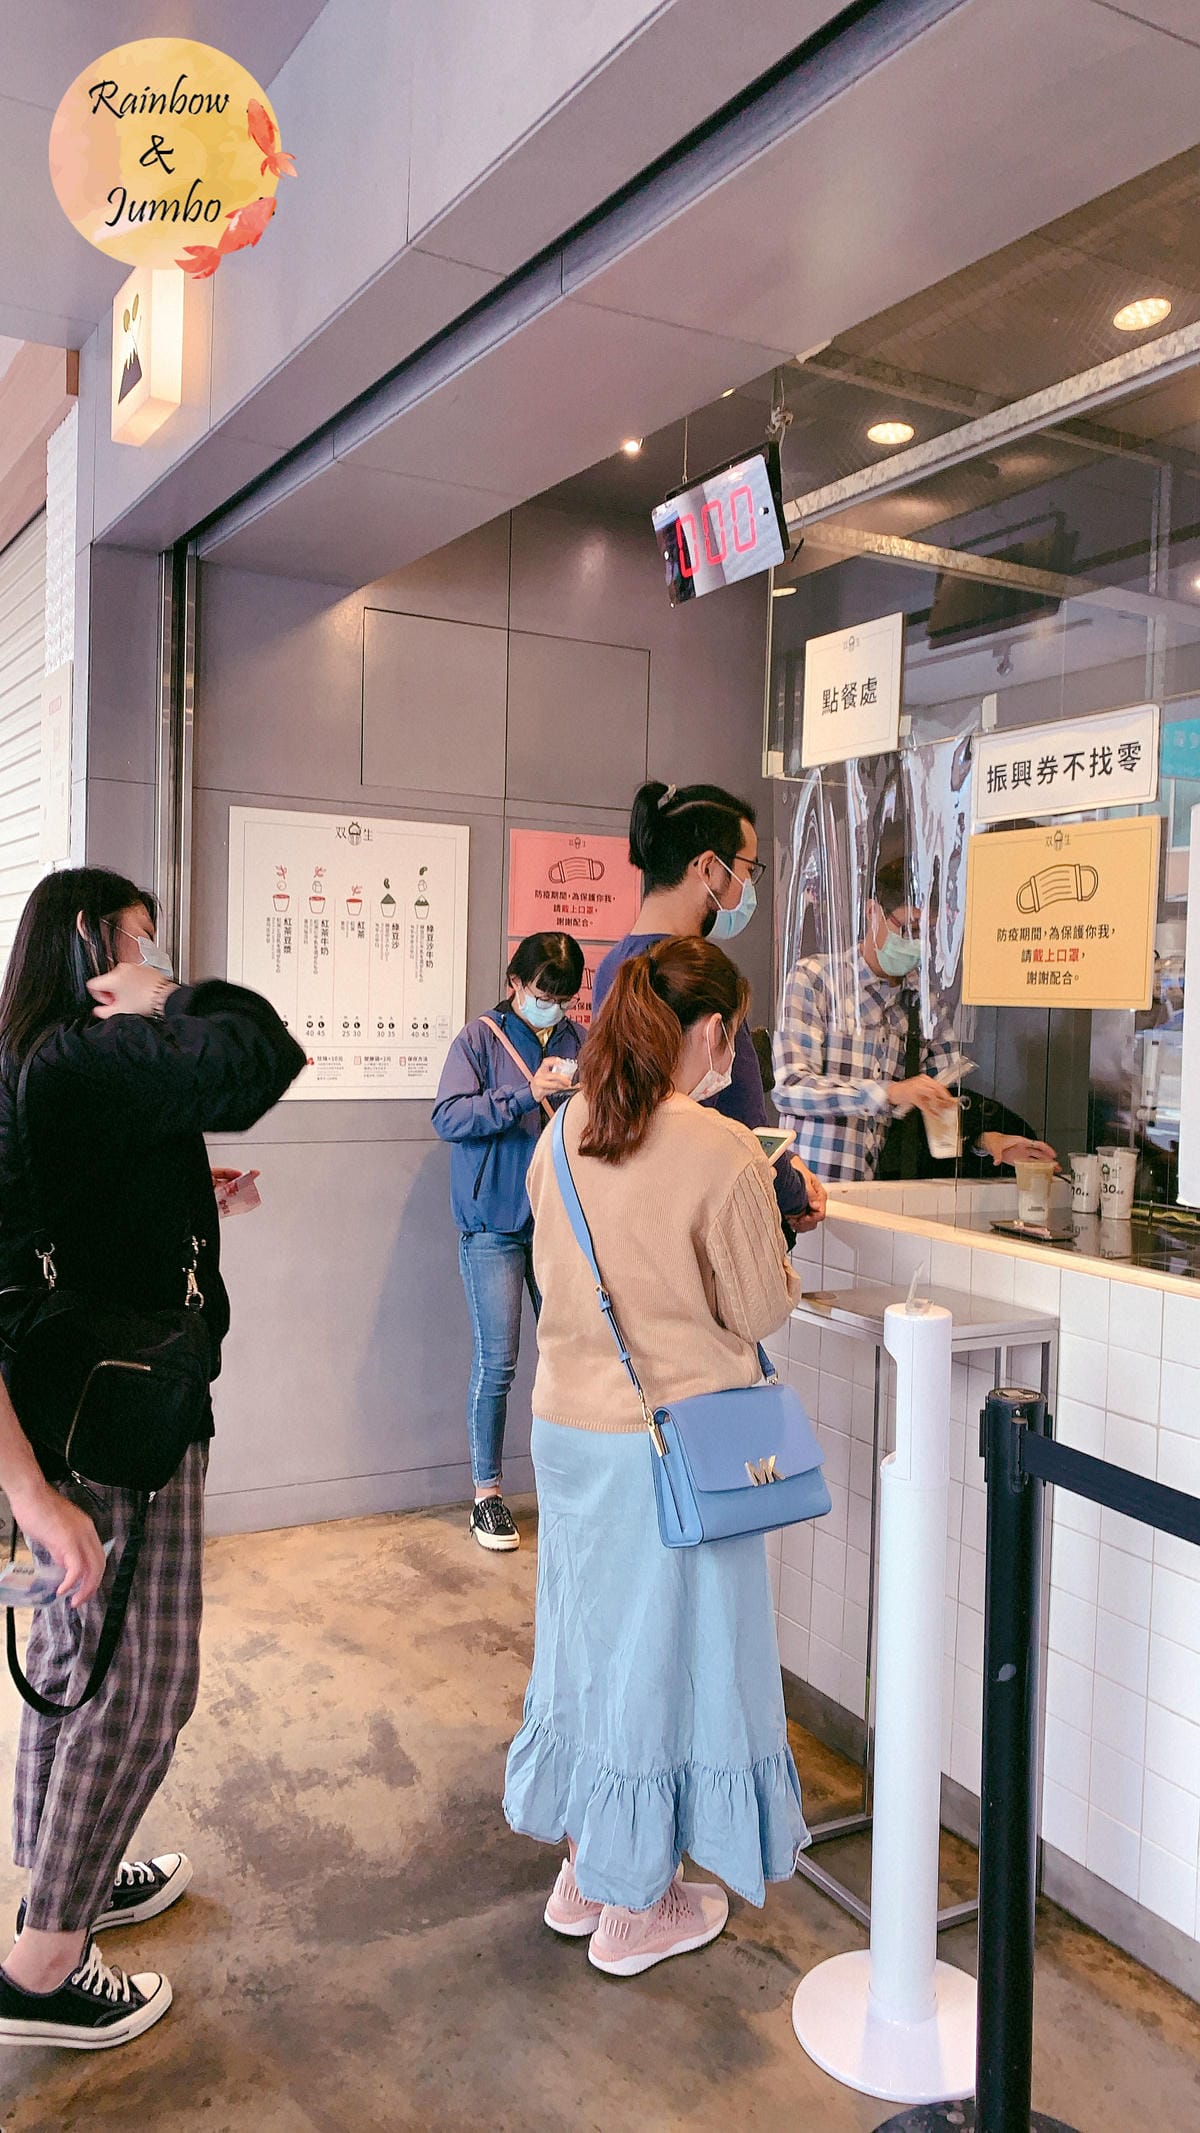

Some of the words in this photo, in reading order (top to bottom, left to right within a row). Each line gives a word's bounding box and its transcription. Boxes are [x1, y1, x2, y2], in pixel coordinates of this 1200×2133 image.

[675, 484, 758, 579] 000
[821, 676, 878, 716] 點餐處
[986, 741, 1142, 794] 振興券不找零
[744, 1455, 786, 1487] MK
